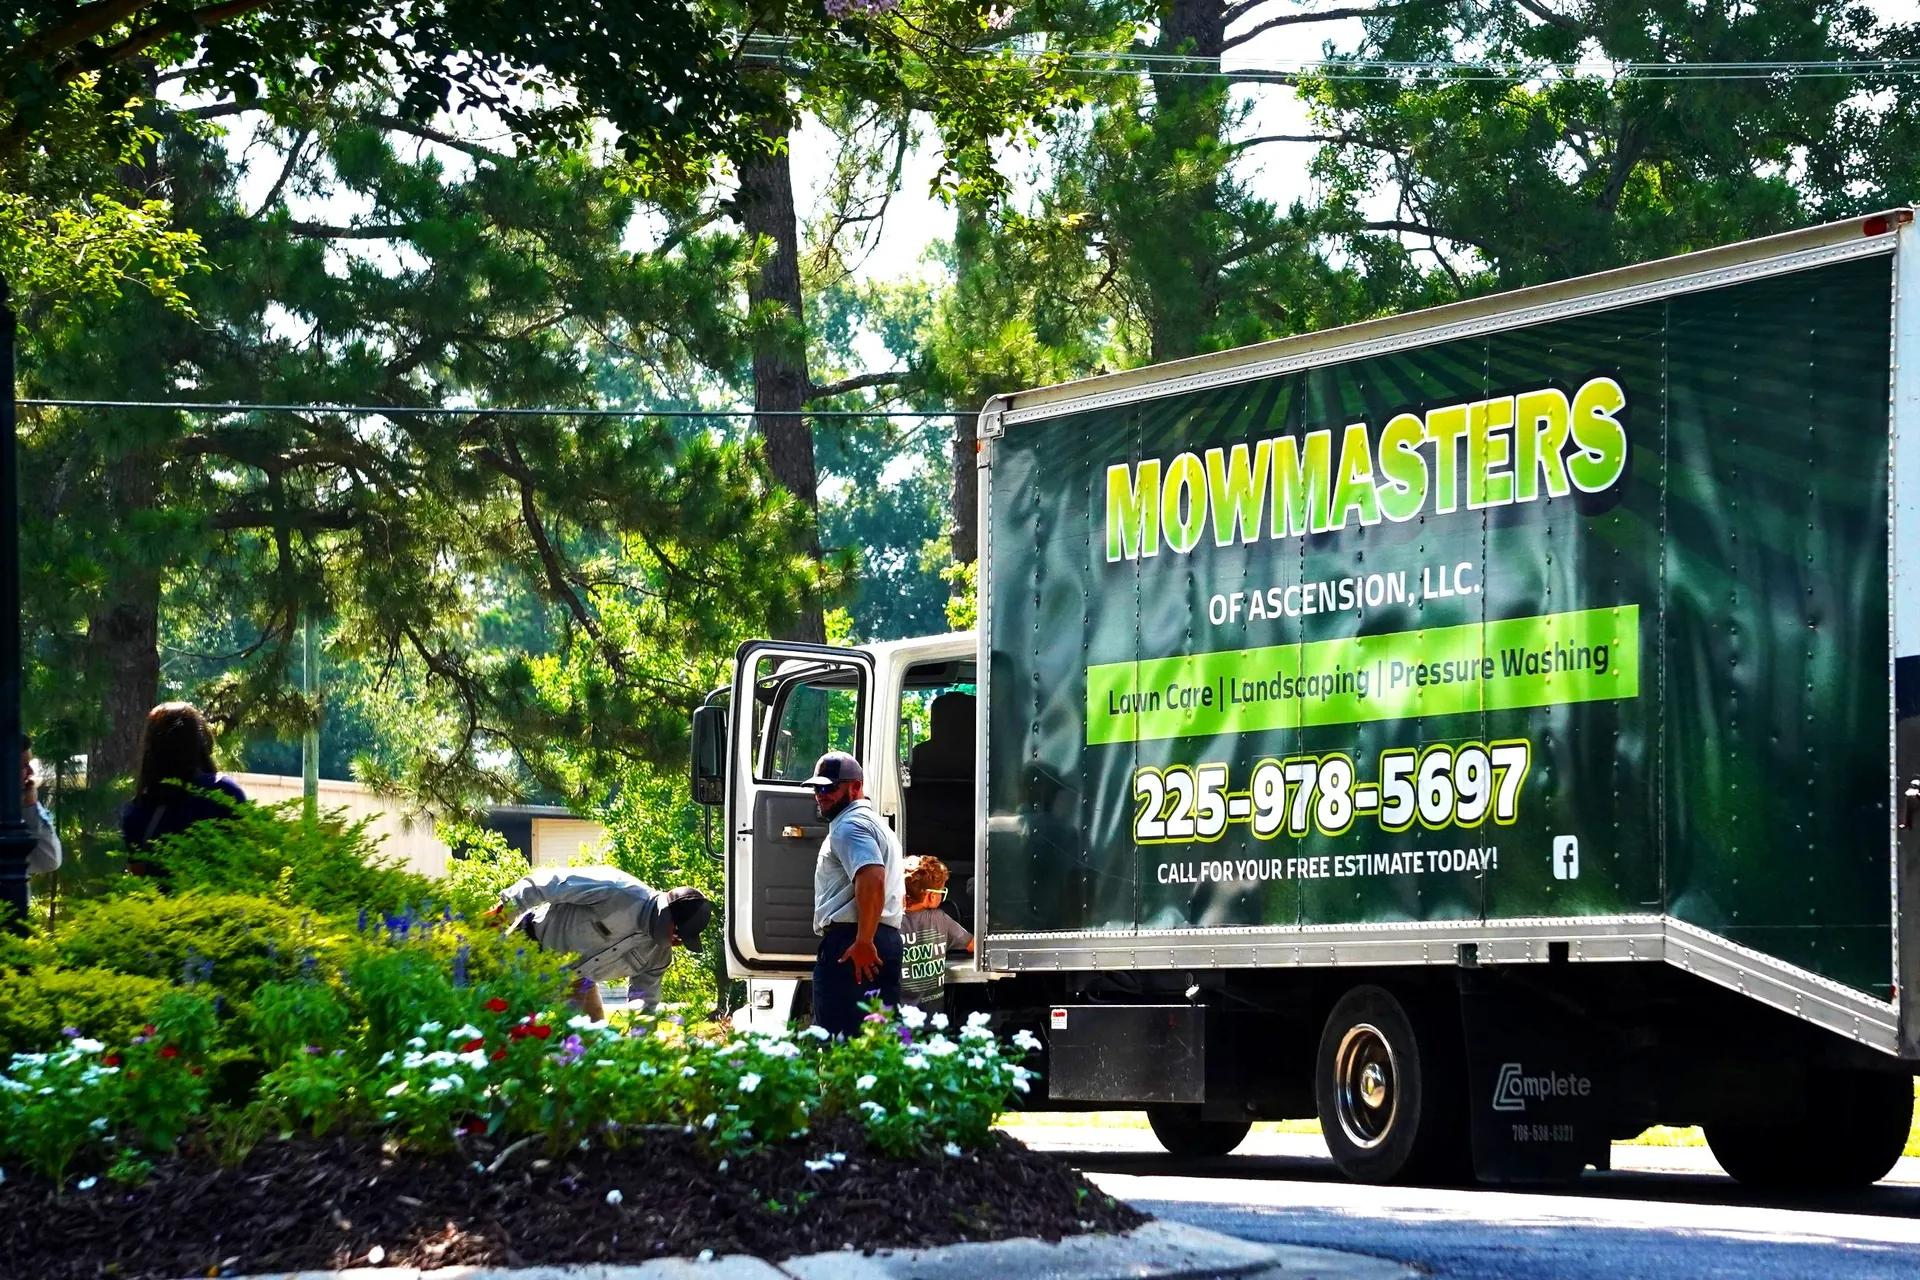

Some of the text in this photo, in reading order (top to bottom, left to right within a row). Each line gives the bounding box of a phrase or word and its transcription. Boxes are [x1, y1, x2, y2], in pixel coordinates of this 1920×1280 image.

[1106, 376, 1627, 562] MOWMASTERS
[1208, 562, 1481, 626] OF ASCENSION, LLC.
[1108, 686, 1161, 716] Lawn
[1166, 681, 1214, 709] Care
[1230, 664, 1369, 703] Landscaping
[1390, 655, 1495, 688] Pressure
[1501, 639, 1610, 678] Washing
[1134, 738, 1531, 844] 225-978-5697
[1157, 846, 1498, 884] CALL FOR YOUR FREE ESTIMATE TODAY!
[901, 957, 945, 979] E MOW
[902, 942, 947, 963] ROW IT
